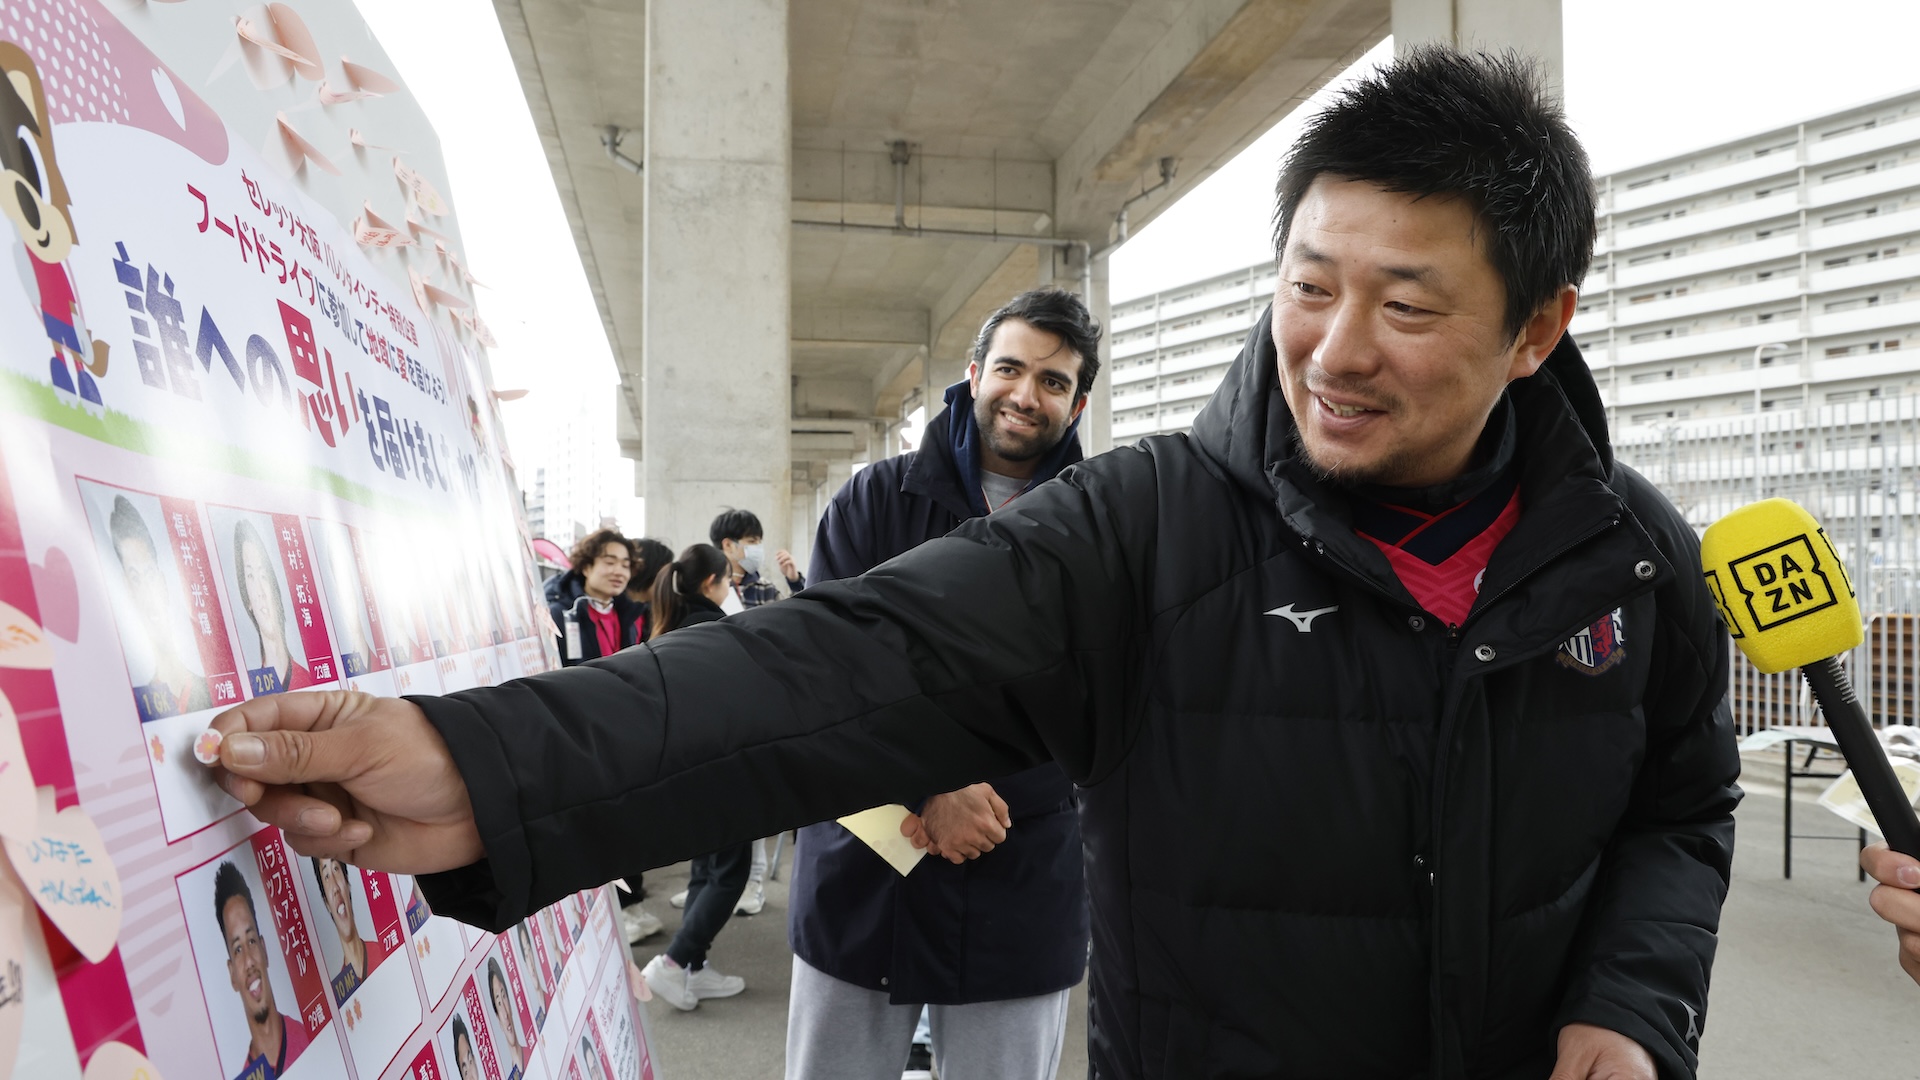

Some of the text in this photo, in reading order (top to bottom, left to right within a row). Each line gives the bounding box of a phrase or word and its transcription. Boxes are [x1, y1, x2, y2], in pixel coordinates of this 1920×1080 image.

[241, 168, 323, 264] セレッソ大阪
[281, 526, 299, 571] 中村
[263, 673, 275, 691] DF
[314, 662, 332, 680] 23歳
[215, 679, 237, 701] 29歳
[335, 980, 345, 1002] 10
[308, 1002, 326, 1033] 29歳
